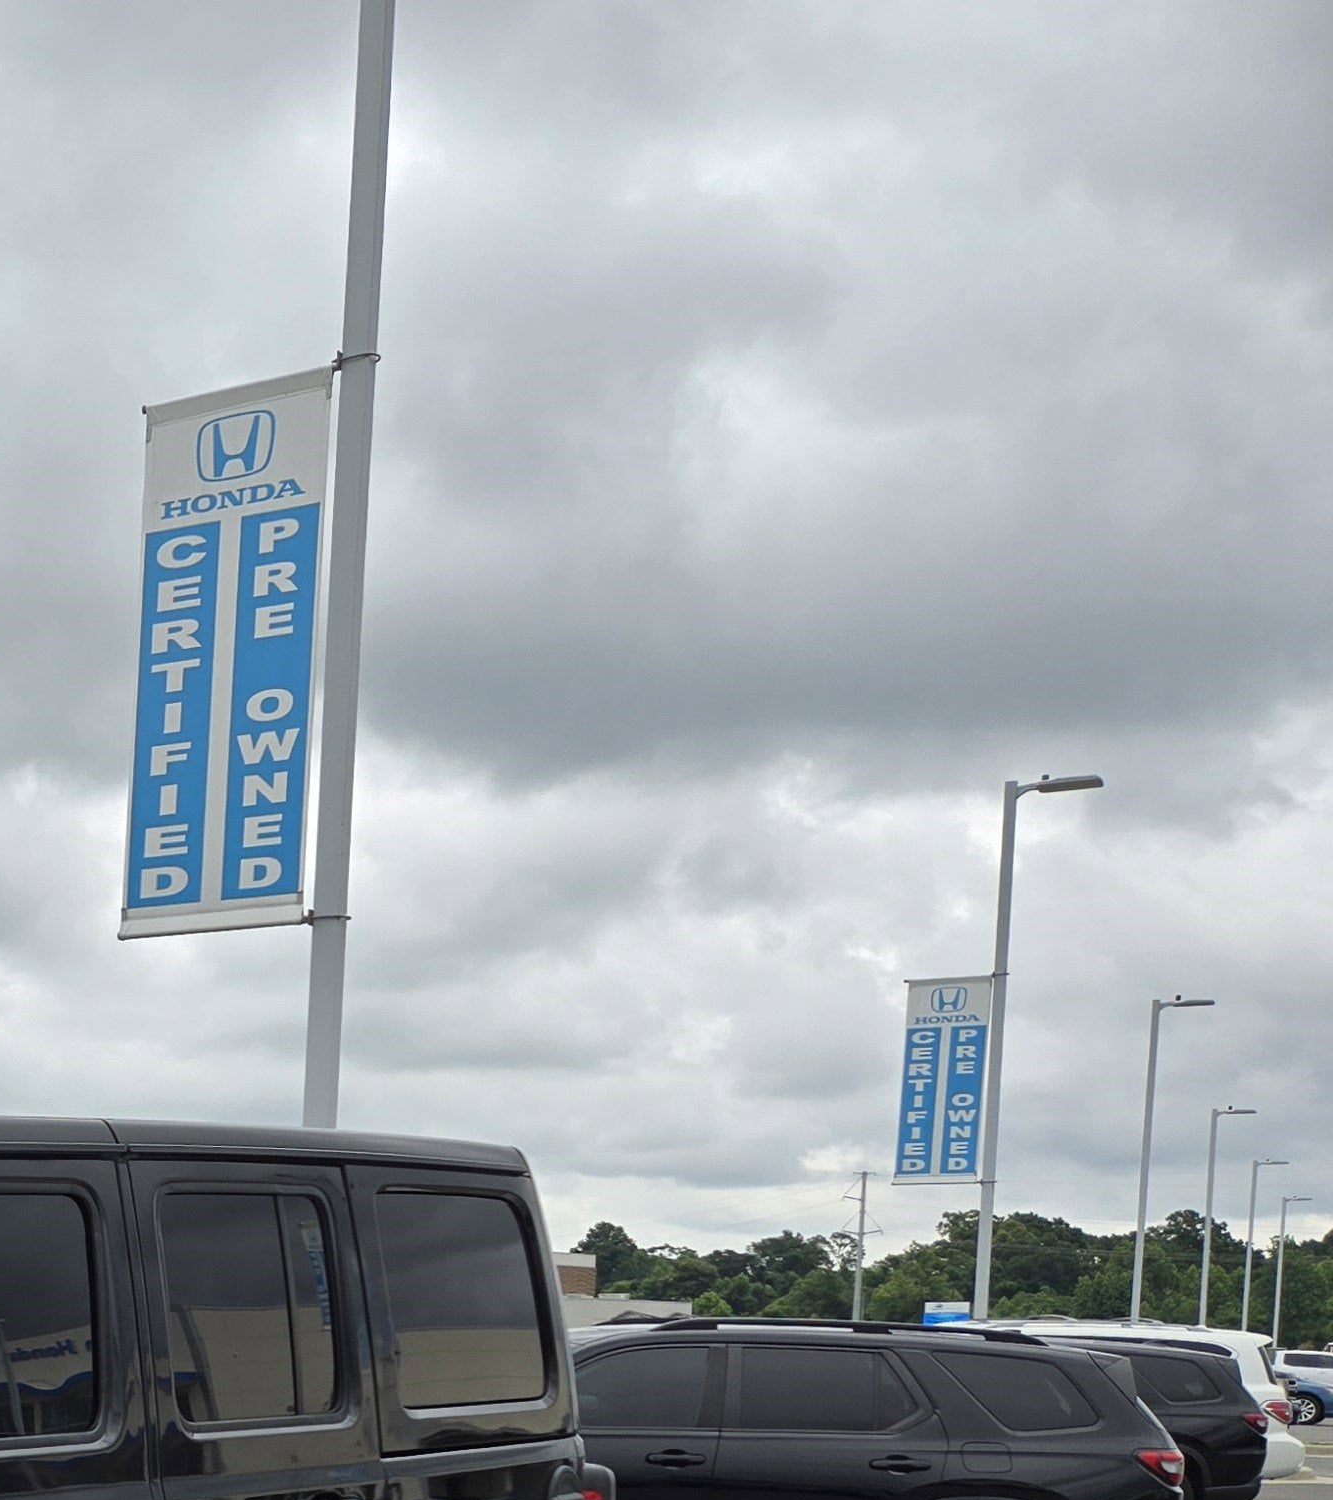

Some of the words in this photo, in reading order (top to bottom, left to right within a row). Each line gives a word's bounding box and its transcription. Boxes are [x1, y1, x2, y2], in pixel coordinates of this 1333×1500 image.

[160, 479, 306, 519] HONDA
[253, 517, 300, 639] PRE
[139, 533, 208, 901] CERTIFIED
[236, 687, 301, 891] OWNED
[913, 1014, 981, 1025] HONDA
[955, 1029, 978, 1075] PRE
[901, 1031, 935, 1172] CERTIFIED
[947, 1093, 977, 1171] OWNED
